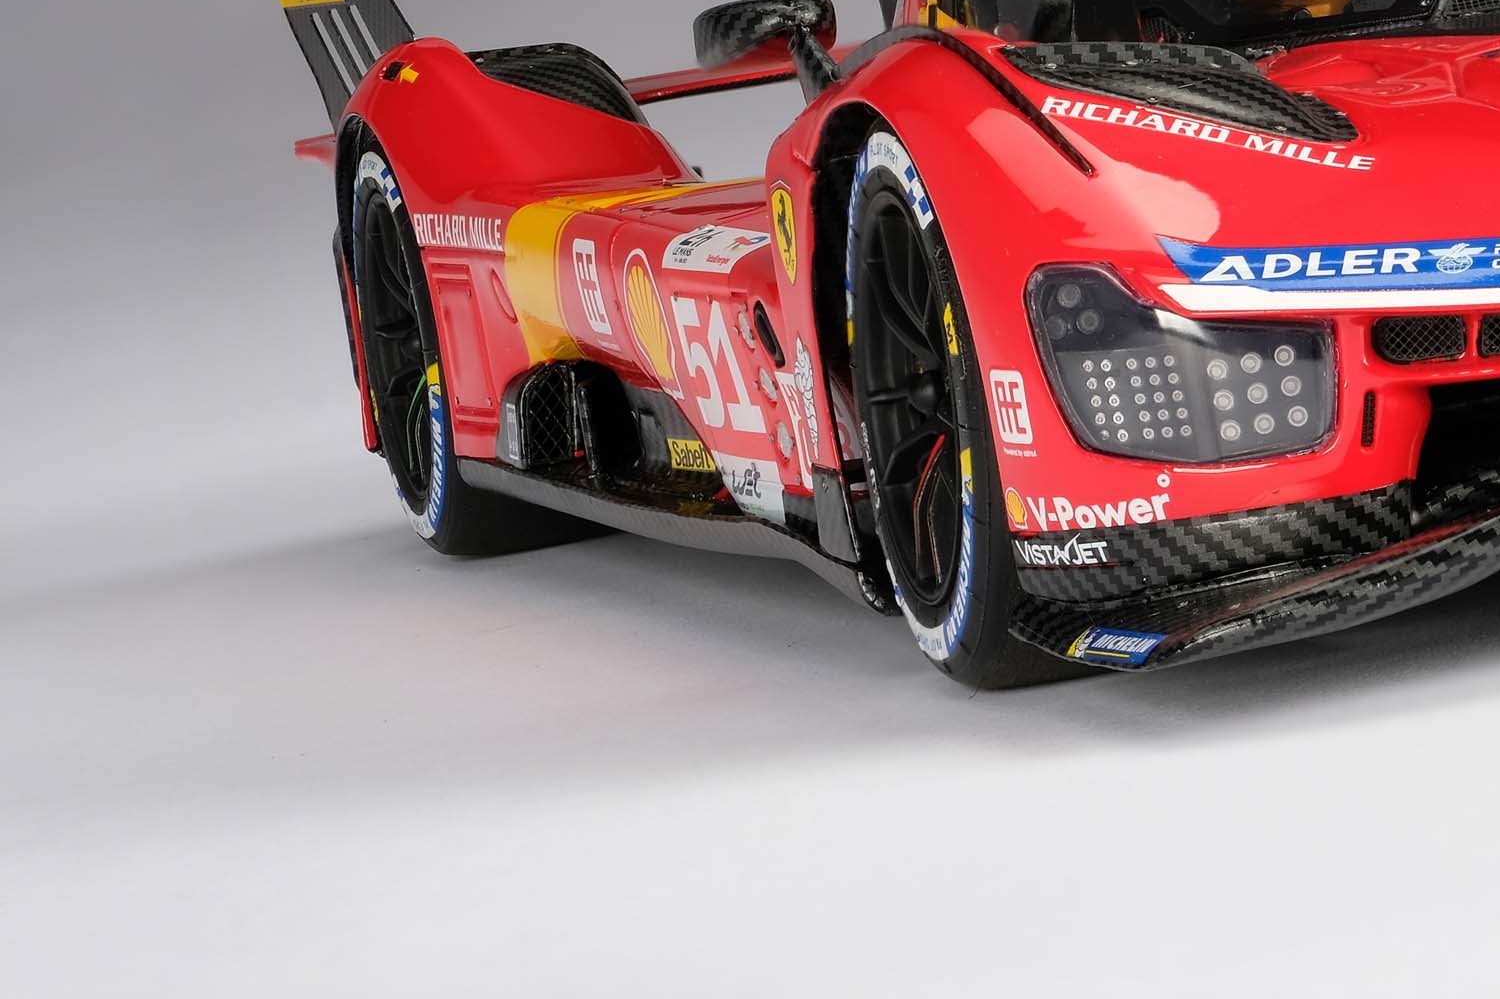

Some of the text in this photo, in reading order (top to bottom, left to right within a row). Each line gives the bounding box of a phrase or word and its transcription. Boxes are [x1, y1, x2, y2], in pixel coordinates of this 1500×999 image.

[1039, 95, 1376, 171] RICHARD MILLE
[413, 213, 505, 252] RICHARD MILLE
[1199, 246, 1422, 283] ADLER
[670, 296, 767, 434] 51
[672, 442, 712, 470] Sabelt
[1026, 492, 1171, 532] V-Power
[1091, 633, 1158, 654] MICHELIN
